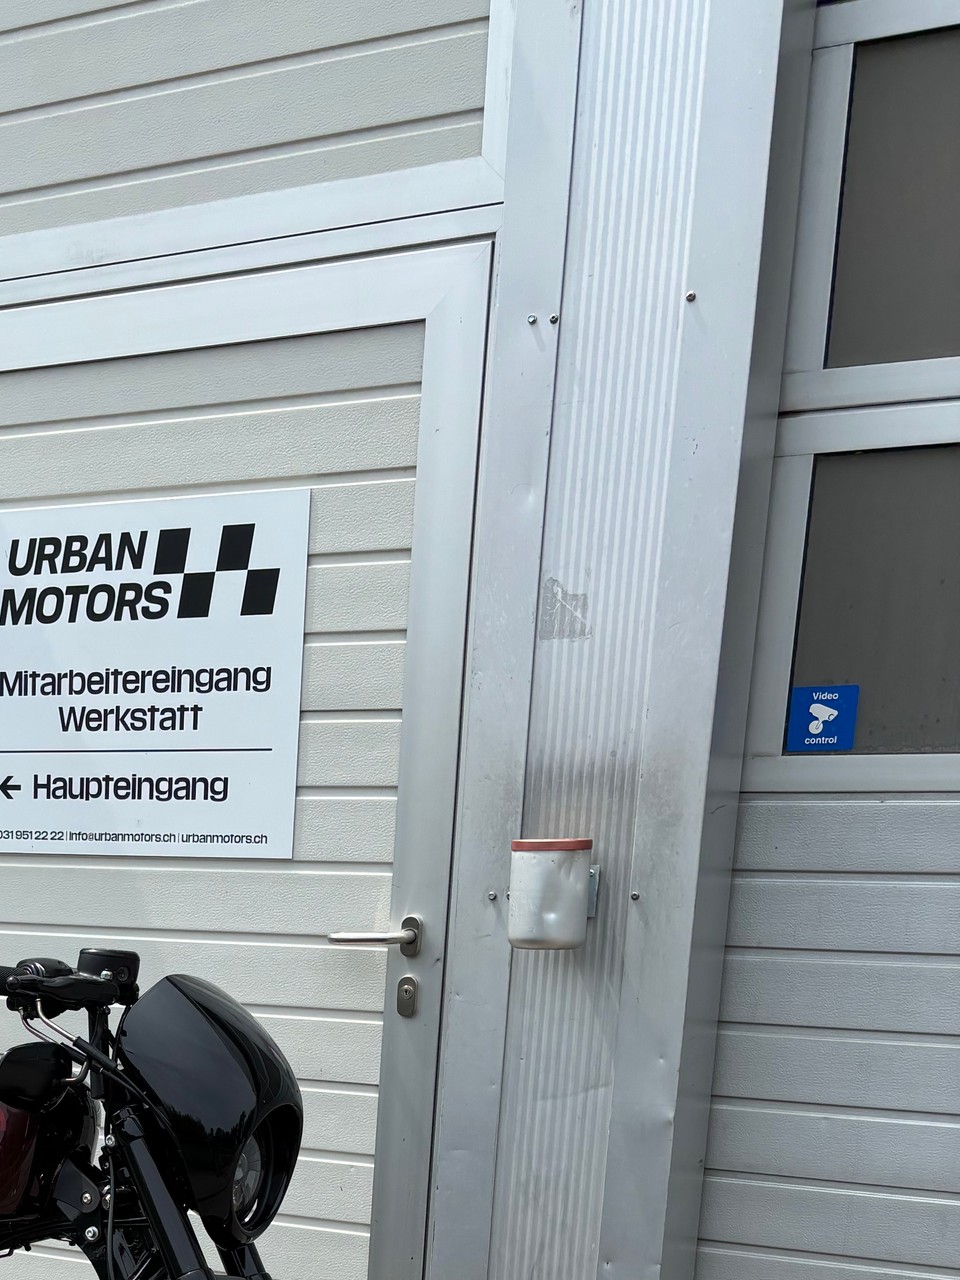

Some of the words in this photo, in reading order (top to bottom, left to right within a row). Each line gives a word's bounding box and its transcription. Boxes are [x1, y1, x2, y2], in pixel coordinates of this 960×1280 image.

[8, 531, 149, 576] URBAN
[0, 666, 272, 697] Mitarbeitereingang
[812, 691, 839, 700] Video
[58, 704, 203, 732] Werkstatt
[804, 736, 838, 744] control
[32, 773, 230, 801] Haupteingang
[181, 832, 268, 844] urbanmotors.ch
